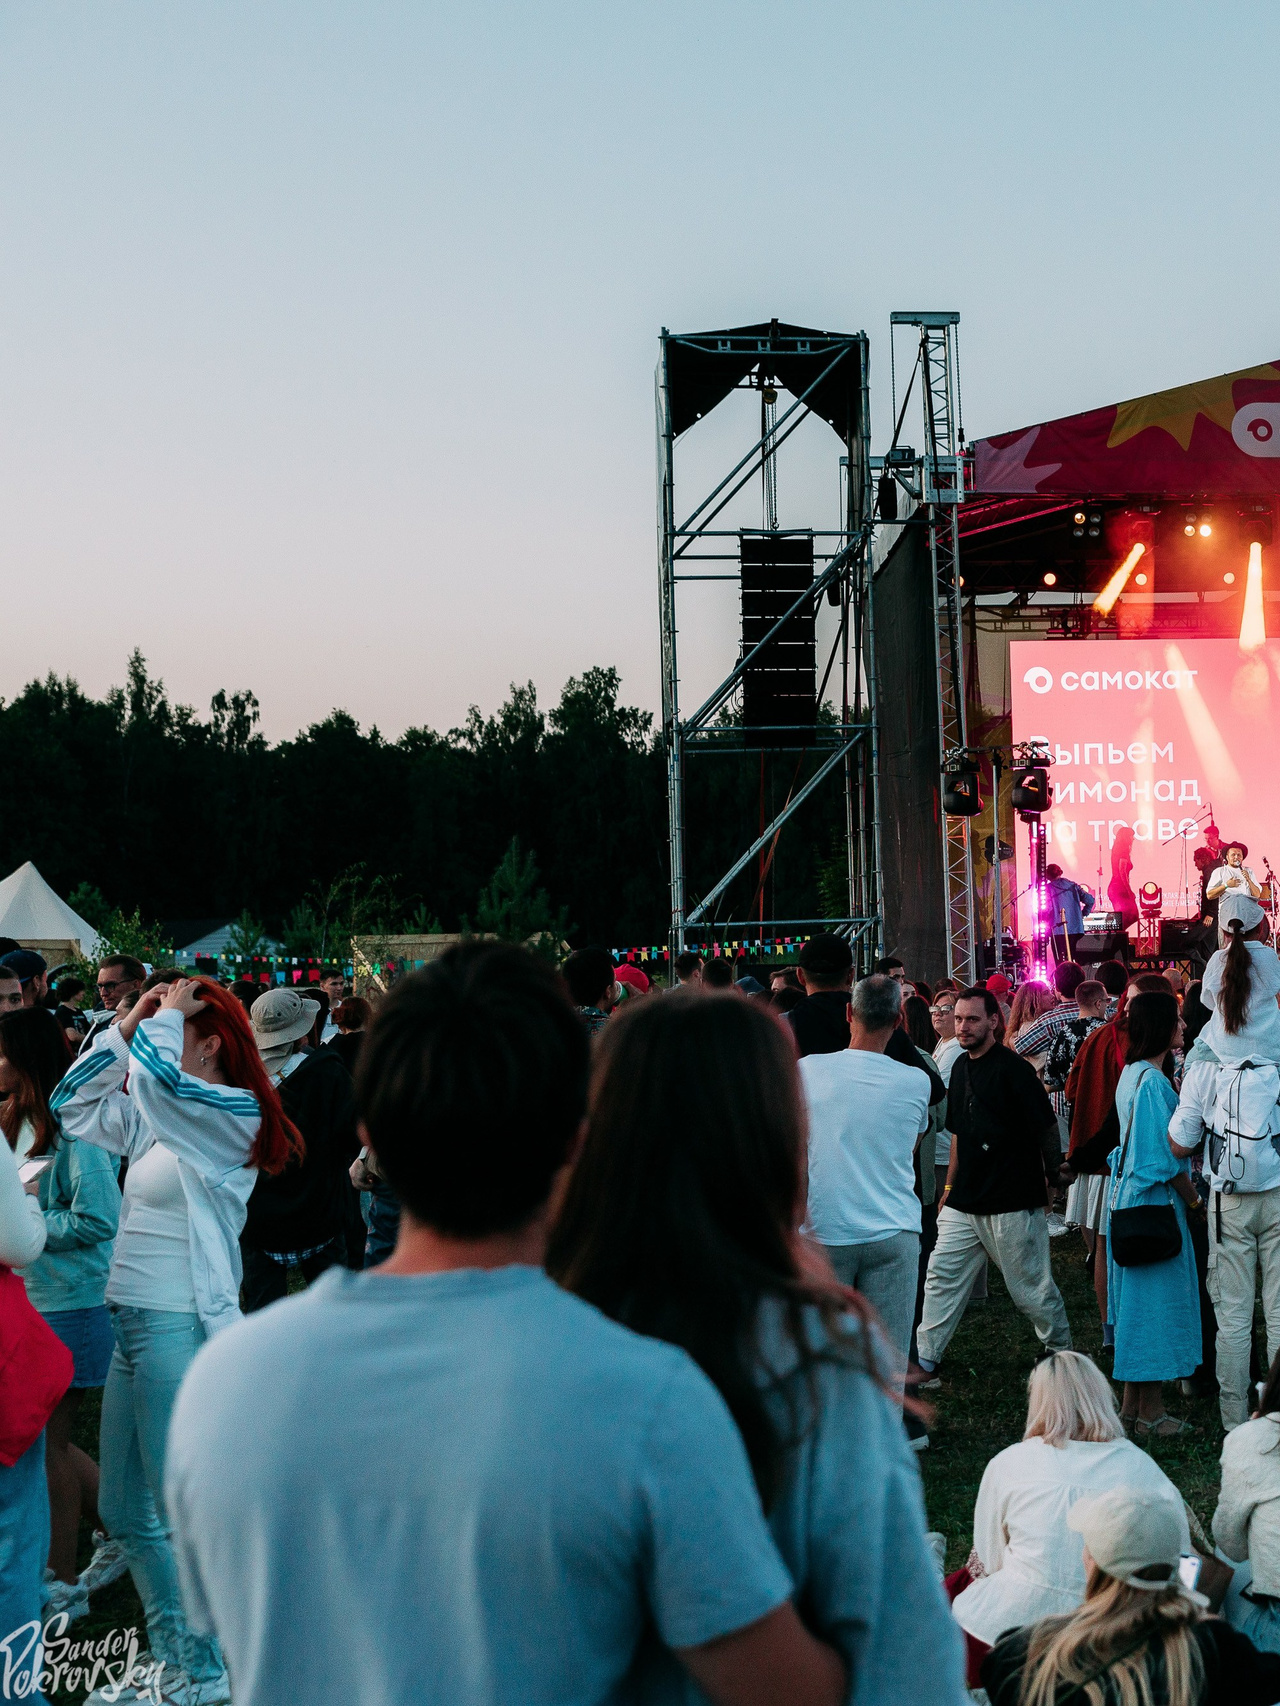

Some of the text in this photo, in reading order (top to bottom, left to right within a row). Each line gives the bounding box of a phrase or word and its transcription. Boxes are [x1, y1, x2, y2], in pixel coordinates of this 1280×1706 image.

[1060, 669, 1198, 691] самокат
[1030, 735, 1174, 766] Выпьем
[1055, 779, 1202, 807] имонад
